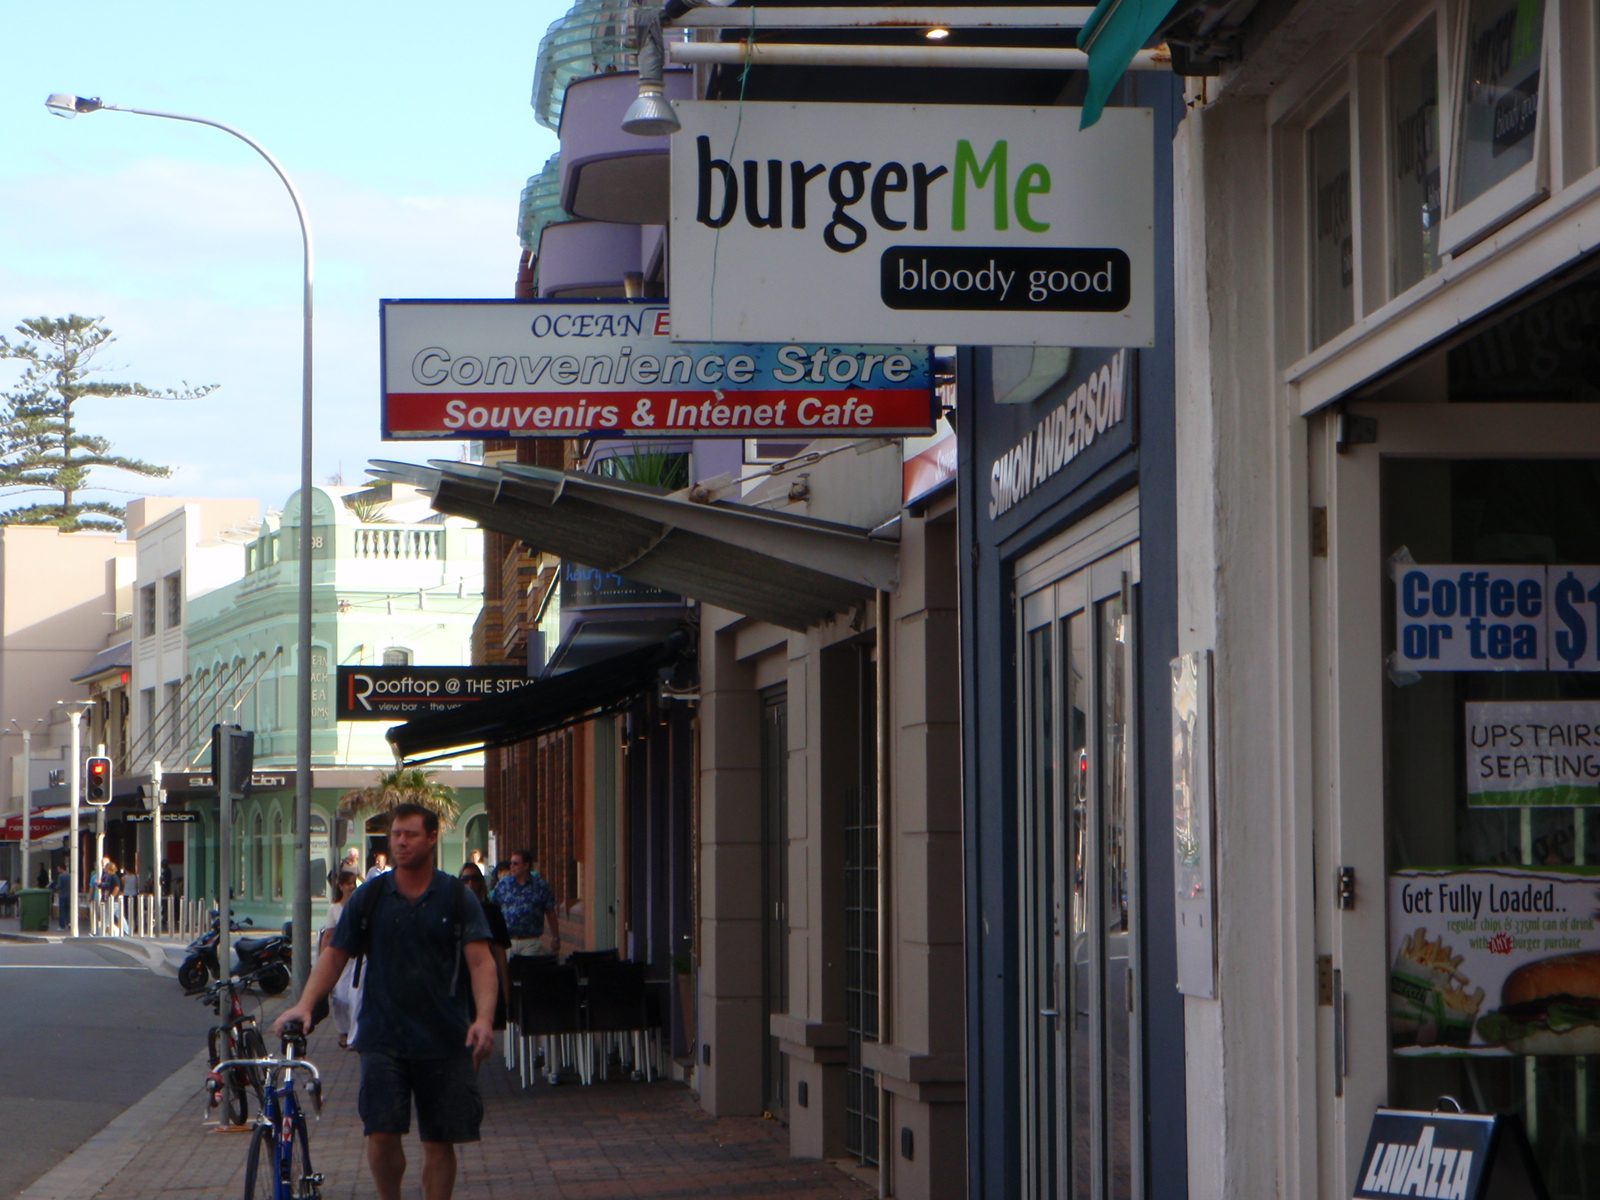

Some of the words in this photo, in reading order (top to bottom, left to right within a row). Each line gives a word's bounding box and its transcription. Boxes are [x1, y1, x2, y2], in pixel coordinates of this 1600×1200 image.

[696, 134, 1051, 252] burgerMe
[897, 258, 1015, 301] bloody
[1028, 262, 1112, 303] good
[532, 313, 643, 339] OCEAN
[411, 345, 756, 386] Convenience
[772, 345, 913, 383] Store
[442, 399, 620, 429] Souvenirs
[629, 402, 656, 428] &
[665, 401, 787, 426] Intenet
[797, 399, 875, 425] Cafe
[989, 431, 1032, 520] SIMON
[1032, 347, 1125, 489] ANDERSON
[1403, 571, 1542, 618] Coffee
[1403, 624, 1453, 660] or
[1466, 617, 1537, 660] tea
[348, 673, 439, 711] Rooftop
[466, 680, 492, 693] THE
[1471, 723, 1600, 748] UPSTAIRS
[1480, 754, 1600, 778] SEATING
[1402, 884, 1432, 913] Get
[1439, 884, 1482, 920] Fully
[1362, 1126, 1473, 1200] LAVAZZA
